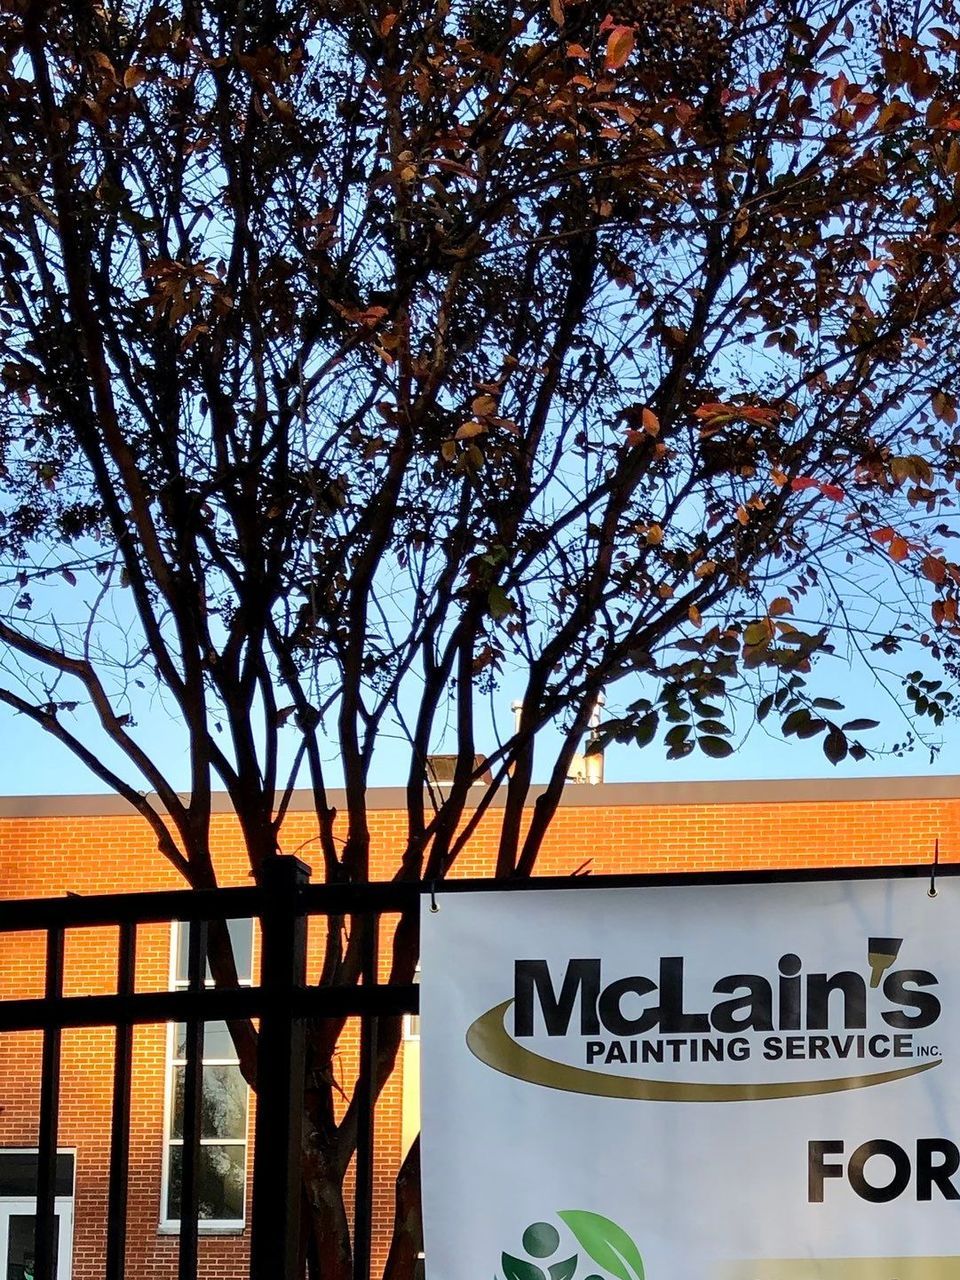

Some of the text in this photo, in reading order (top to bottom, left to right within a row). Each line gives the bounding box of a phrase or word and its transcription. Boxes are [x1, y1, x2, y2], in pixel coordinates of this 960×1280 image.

[514, 937, 941, 1037] McLain's
[586, 1034, 942, 1064] PAINTING SERVICE INC.
